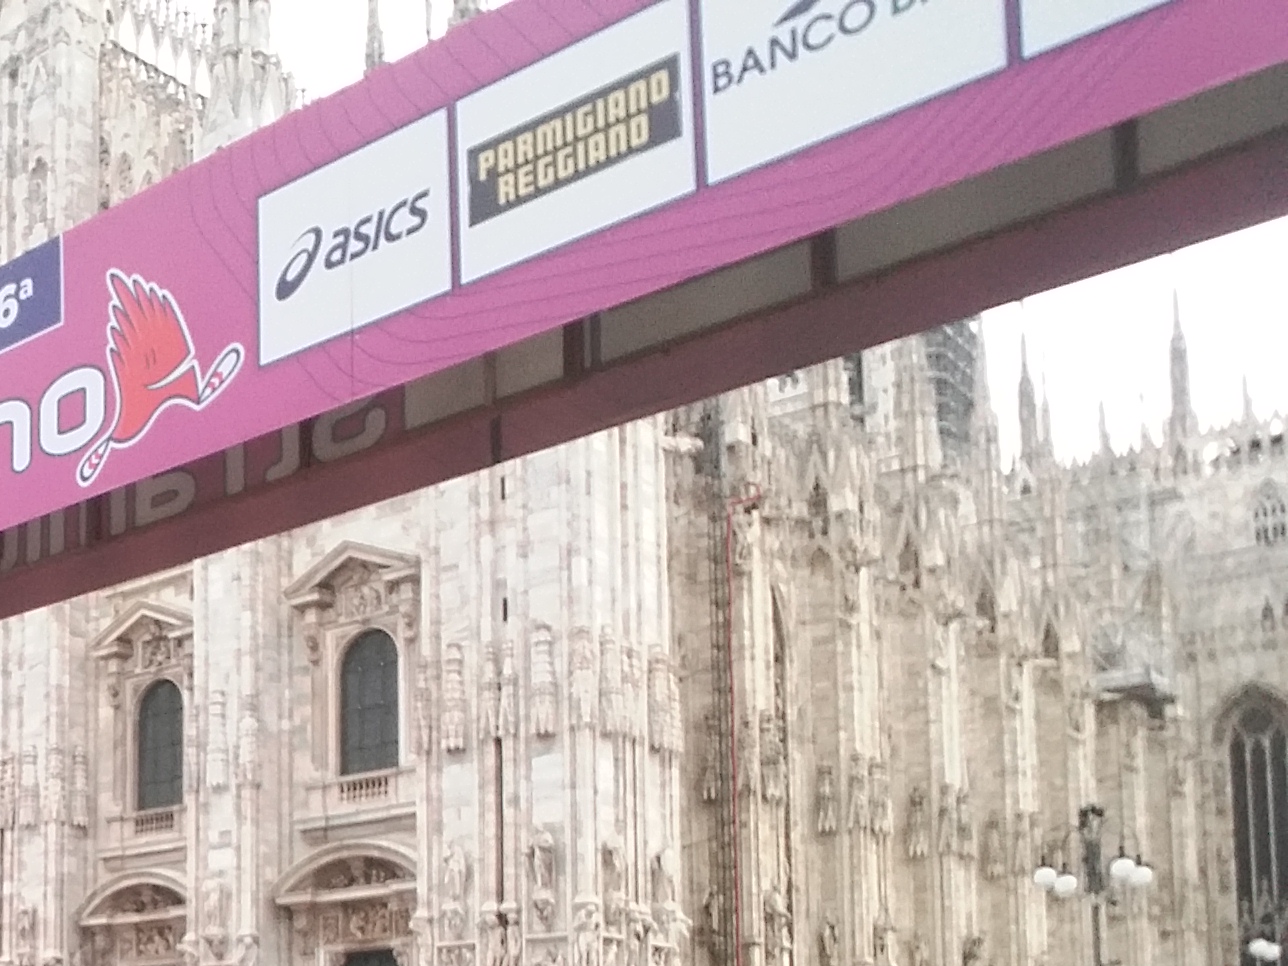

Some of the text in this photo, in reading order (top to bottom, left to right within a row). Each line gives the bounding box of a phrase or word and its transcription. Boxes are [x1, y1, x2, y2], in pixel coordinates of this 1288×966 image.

[712, 0, 876, 94] BANCO
[478, 69, 670, 181] PARMIGIANO
[497, 113, 650, 206] REGGIANO
